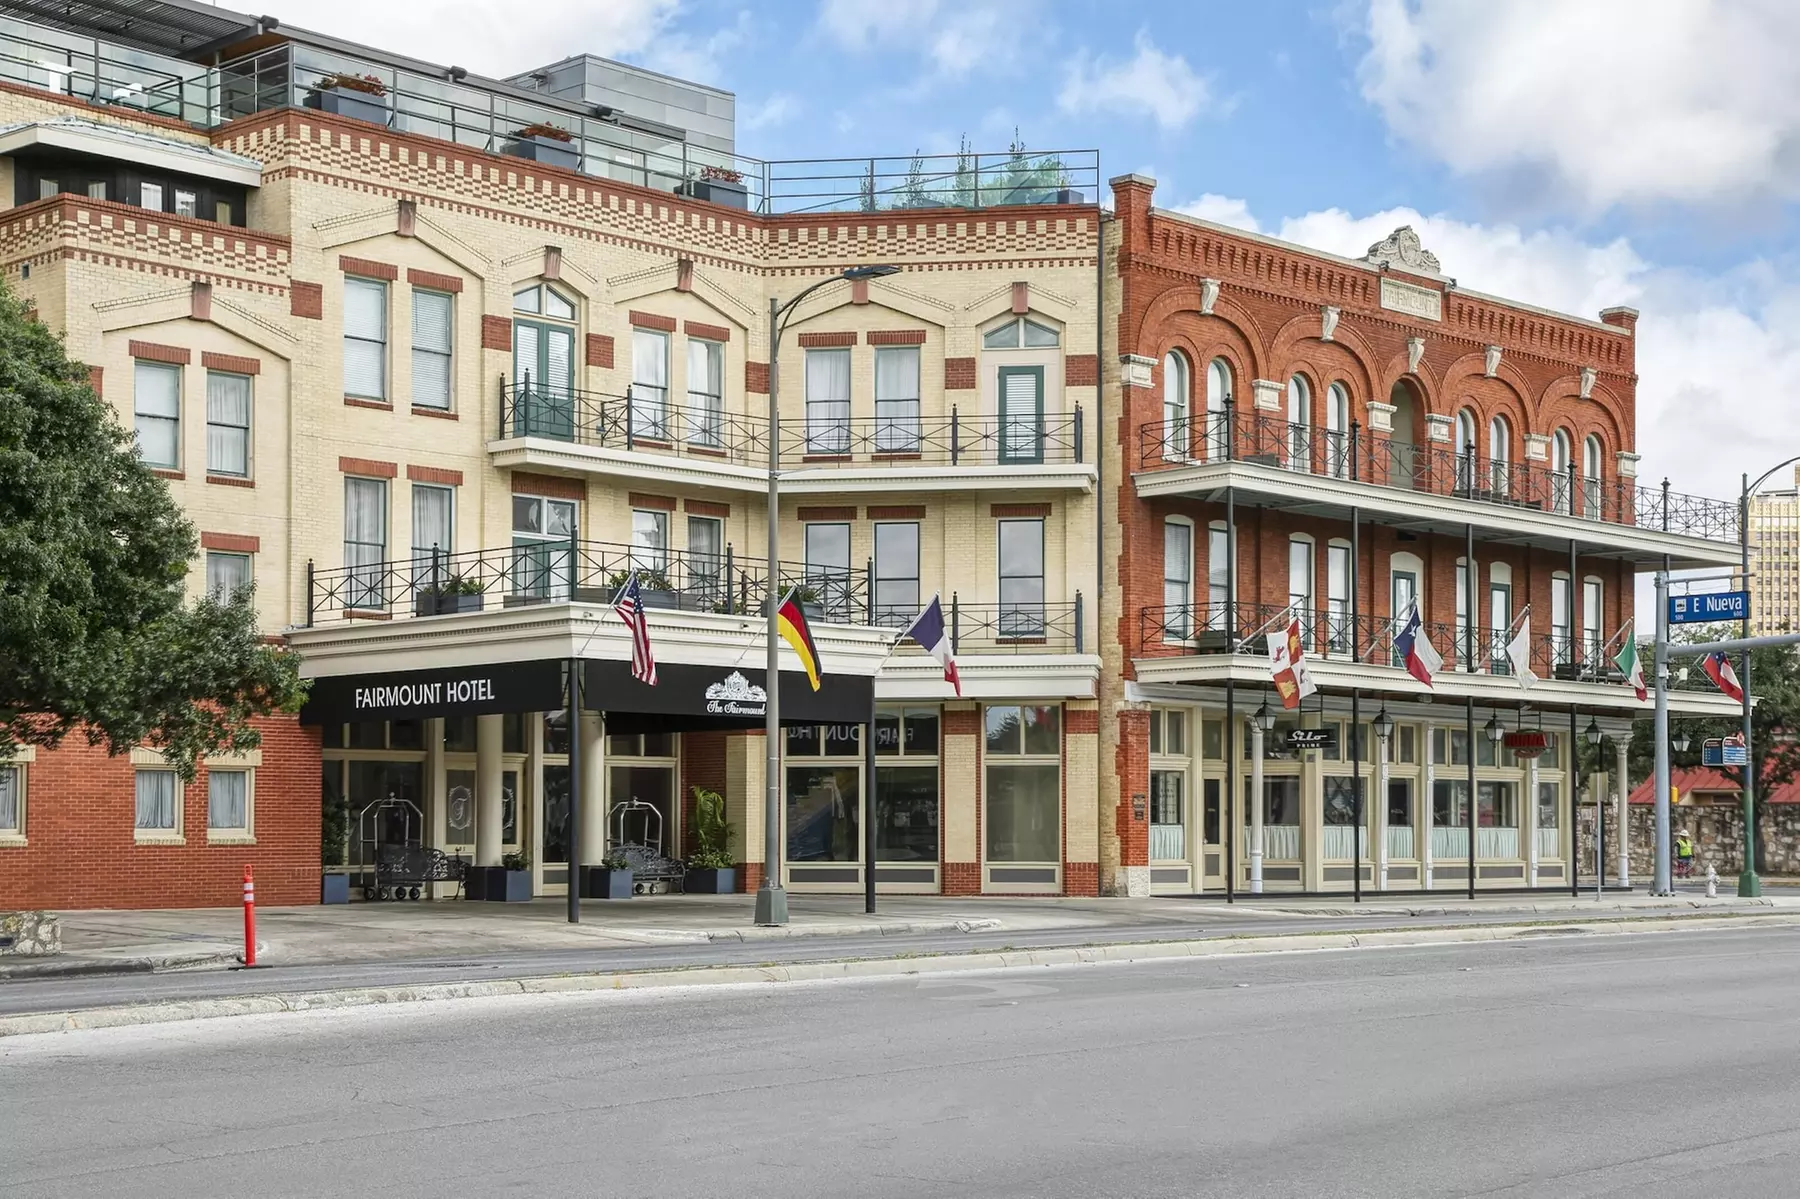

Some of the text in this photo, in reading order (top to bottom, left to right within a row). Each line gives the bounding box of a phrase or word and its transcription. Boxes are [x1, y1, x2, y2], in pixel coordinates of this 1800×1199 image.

[1693, 596, 1742, 613] E Nueva
[355, 679, 496, 709] FAIRMOUNT HOTEL
[706, 700, 767, 715] The Fairmount
[1288, 730, 1328, 741] Silo
